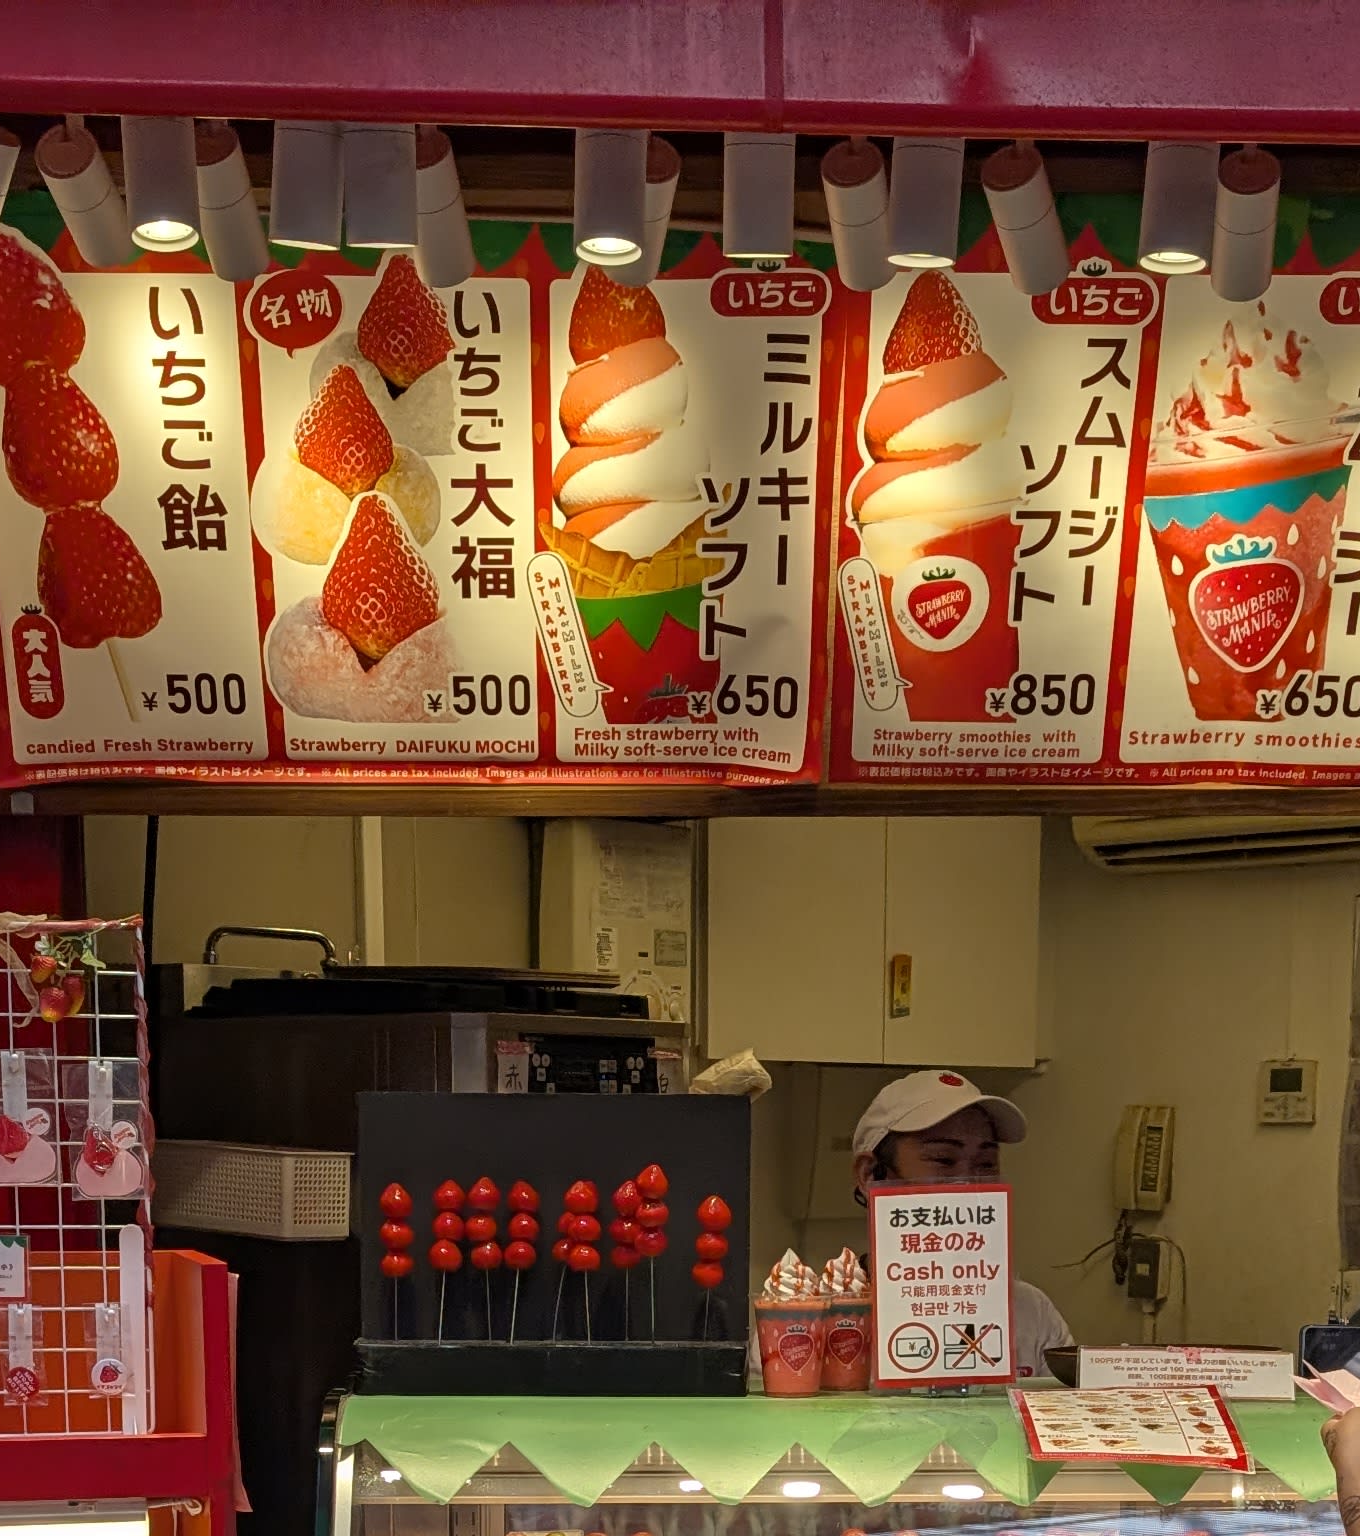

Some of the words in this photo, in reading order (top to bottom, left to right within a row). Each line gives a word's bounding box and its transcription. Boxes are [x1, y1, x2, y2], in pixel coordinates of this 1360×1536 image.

[259, 288, 332, 329] 名物
[727, 282, 817, 310] いちご
[1049, 284, 1142, 315] いちご
[148, 286, 228, 551] いちご飴
[450, 291, 516, 599] いちご大福
[757, 334, 812, 586] ミルキー
[1067, 338, 1131, 606] スムージー
[1014, 444, 1068, 621] ソフト
[701, 478, 750, 658] ソフト
[548, 578, 567, 617] MIX
[1207, 586, 1292, 630] STRAWBERRY
[534, 572, 574, 707] STRAWBERRY
[1222, 612, 1282, 647] MANIA
[23, 630, 54, 703] 大人気
[142, 673, 247, 715] ¥500
[427, 675, 530, 716] ¥500
[691, 675, 798, 718] ¥650
[989, 674, 1095, 716] ¥850
[26, 740, 95, 755] candied
[103, 739, 152, 753] Fresh
[157, 738, 254, 755] Strawberry
[289, 737, 386, 755] Strawberry
[395, 740, 471, 754] DAIFUKU
[475, 740, 534, 754] MOCHI
[574, 727, 622, 741] Fresh
[627, 727, 717, 743] strawberry
[722, 727, 758, 742] with
[574, 742, 619, 759] Milky
[624, 743, 707, 757] soft-serve
[712, 744, 737, 759] ice
[742, 749, 791, 763] cream
[872, 744, 915, 760] Milky
[919, 744, 995, 758] soft-serve
[999, 745, 1022, 757] ice
[1026, 747, 1080, 758] cream
[873, 728, 951, 743] Strawberry
[959, 730, 1031, 743] smoothies
[1043, 729, 1076, 742] with
[1128, 731, 1244, 748] Strawberry
[334, 768, 349, 777] All
[353, 768, 382, 779] prices
[386, 769, 407, 777] are
[411, 768, 430, 777] tax
[432, 767, 481, 778] included.
[889, 1205, 996, 1228] お支払いは
[900, 1231, 985, 1253] 現金のみ
[886, 1261, 944, 1281] Cash
[952, 1259, 1000, 1280] only
[901, 1284, 986, 1298] 只能用现金支付
[911, 1302, 949, 1317] 현금만
[953, 1301, 978, 1315] 가능
